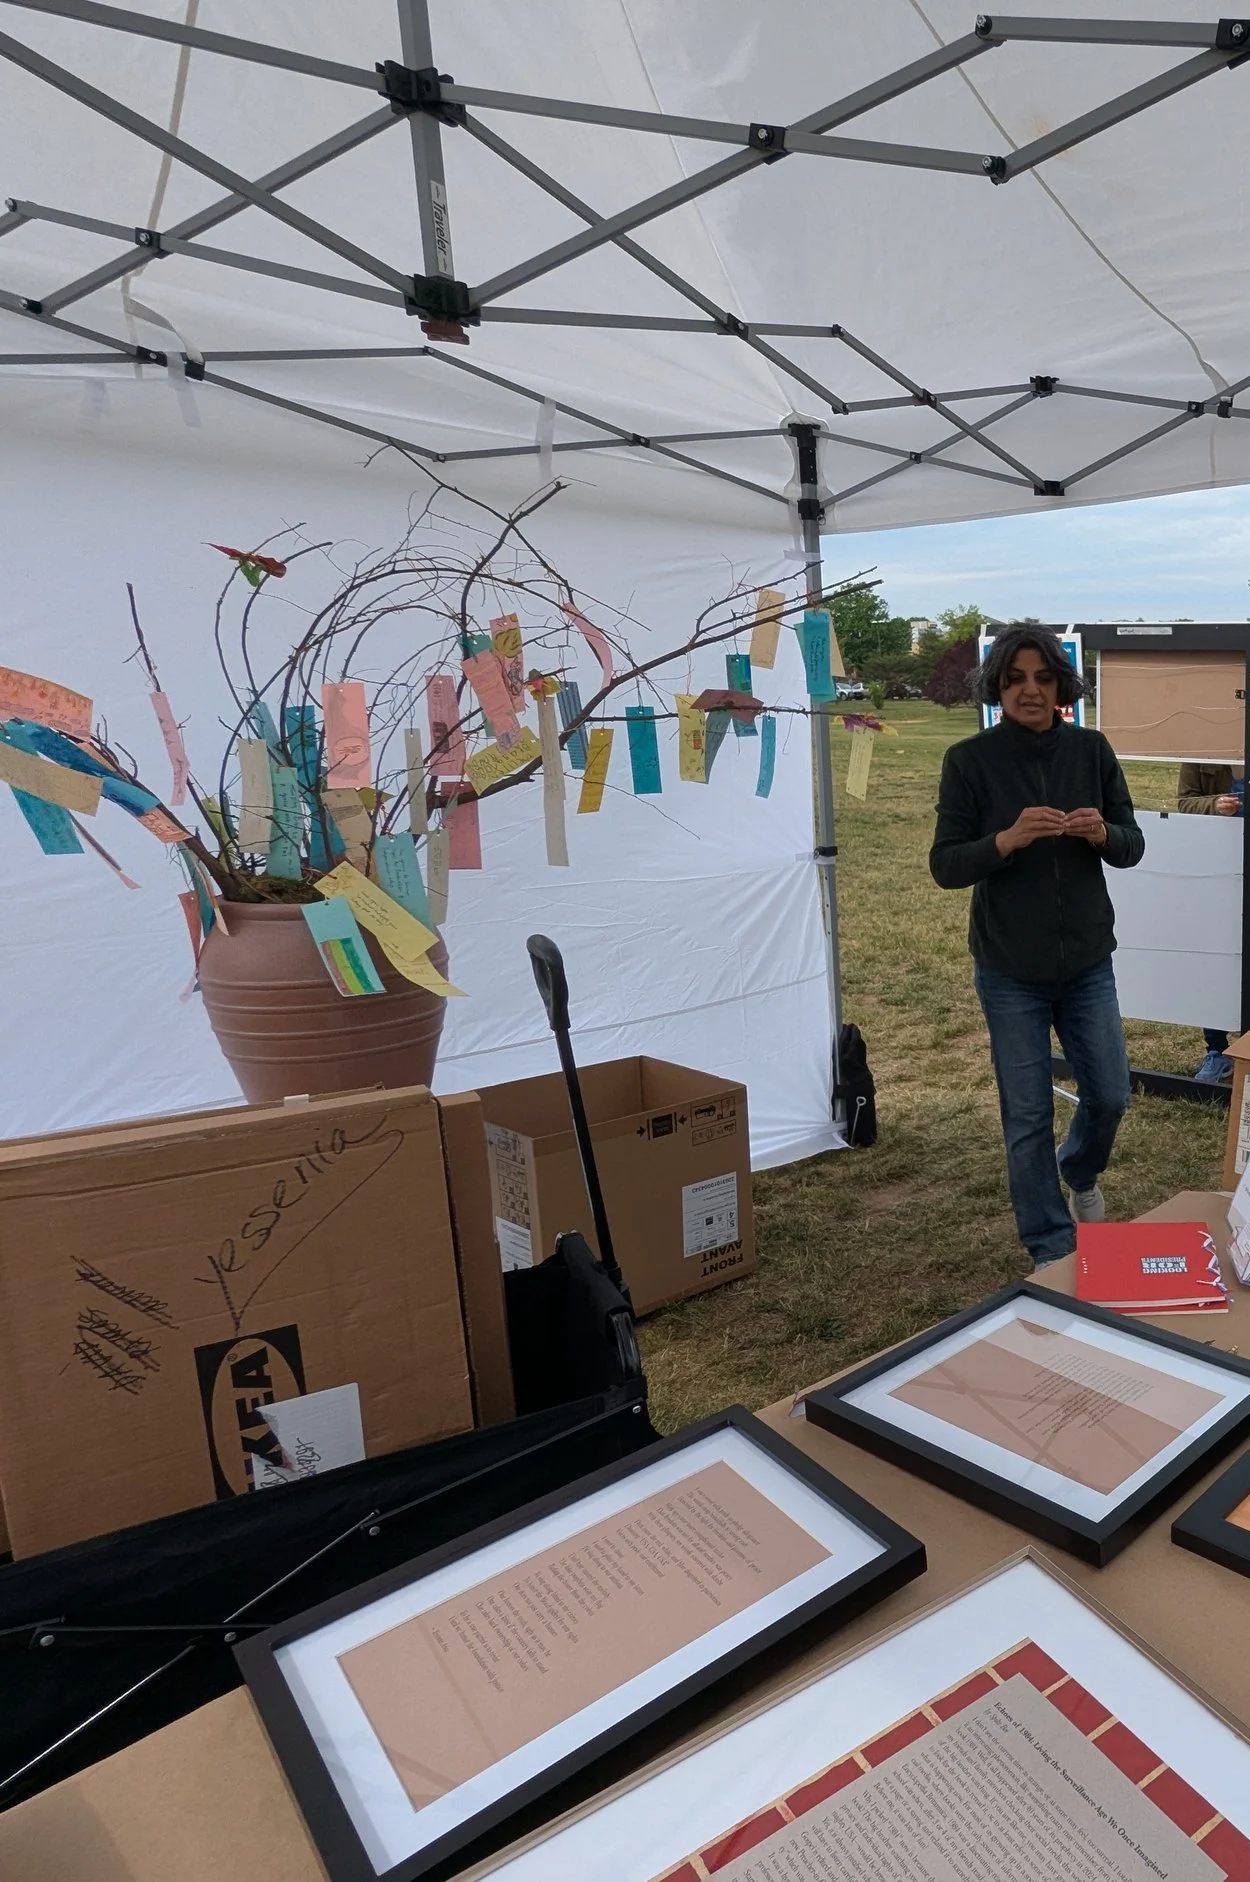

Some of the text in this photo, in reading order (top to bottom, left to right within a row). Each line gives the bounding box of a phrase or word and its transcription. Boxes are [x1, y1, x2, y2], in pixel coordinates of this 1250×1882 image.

[433, 200, 449, 256] Traveler
[194, 1116, 390, 1330] Yesenia
[700, 1239, 743, 1264] AVANT
[700, 1252, 744, 1278] FRONT
[233, 1346, 284, 1491] KEA
[993, 1701, 1170, 1882] Echoes of 1984: Living the Surveillance Age We Once Imagined
